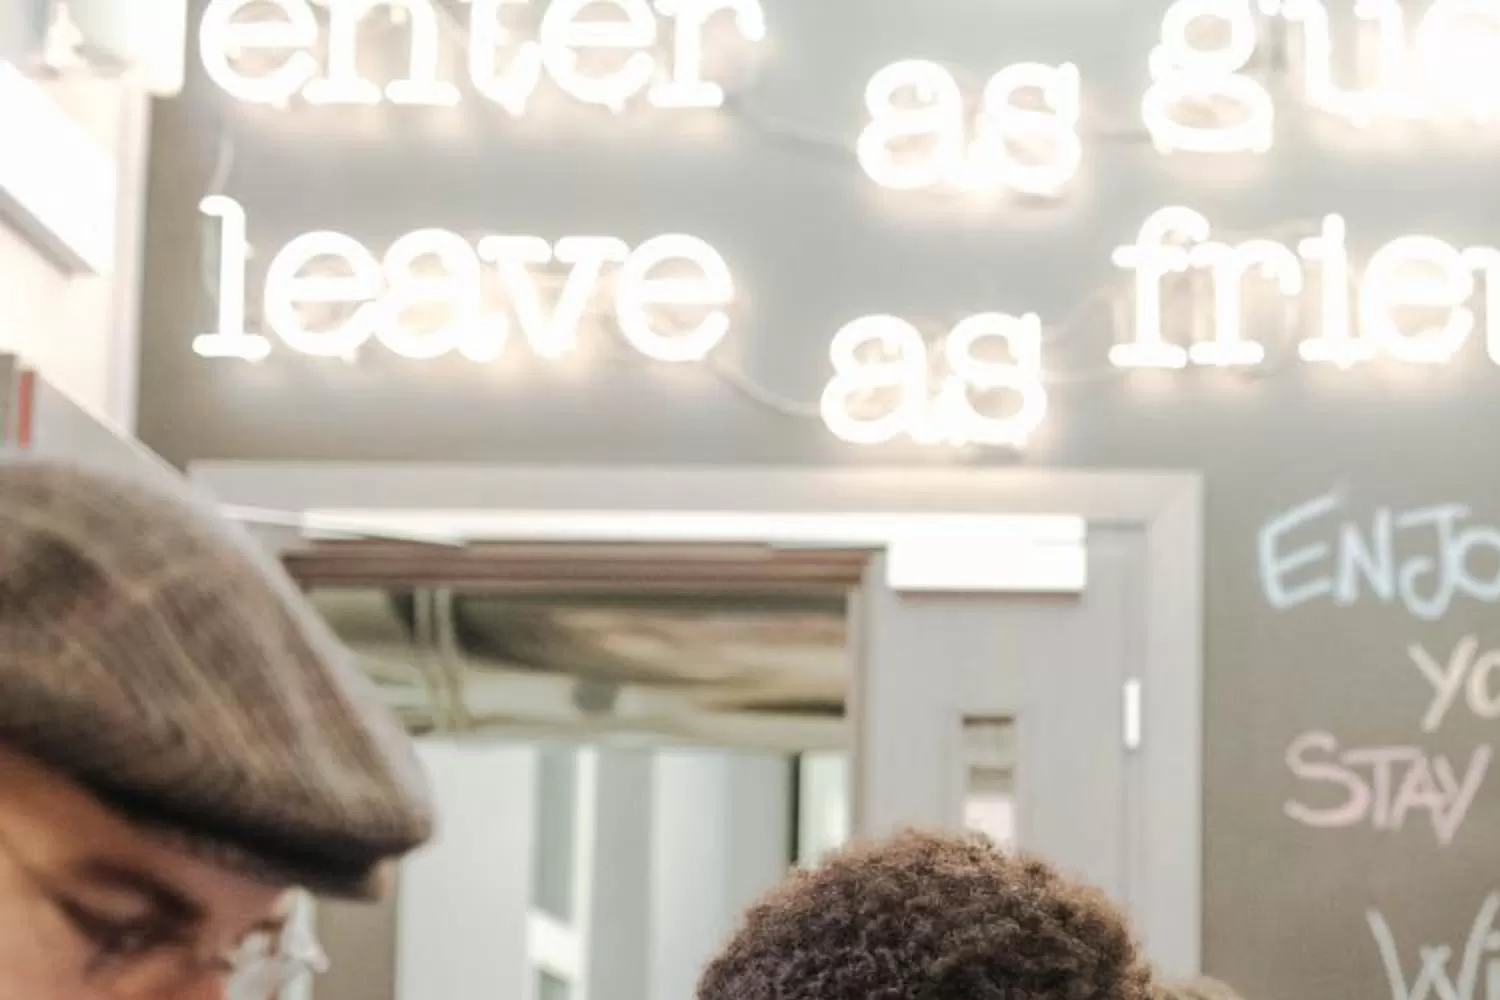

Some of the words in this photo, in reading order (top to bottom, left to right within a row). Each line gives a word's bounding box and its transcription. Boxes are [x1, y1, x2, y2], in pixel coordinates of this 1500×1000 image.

[198, 0, 765, 116] enter
[857, 59, 1082, 195] as
[193, 196, 736, 362] leave
[820, 312, 1047, 448] as
